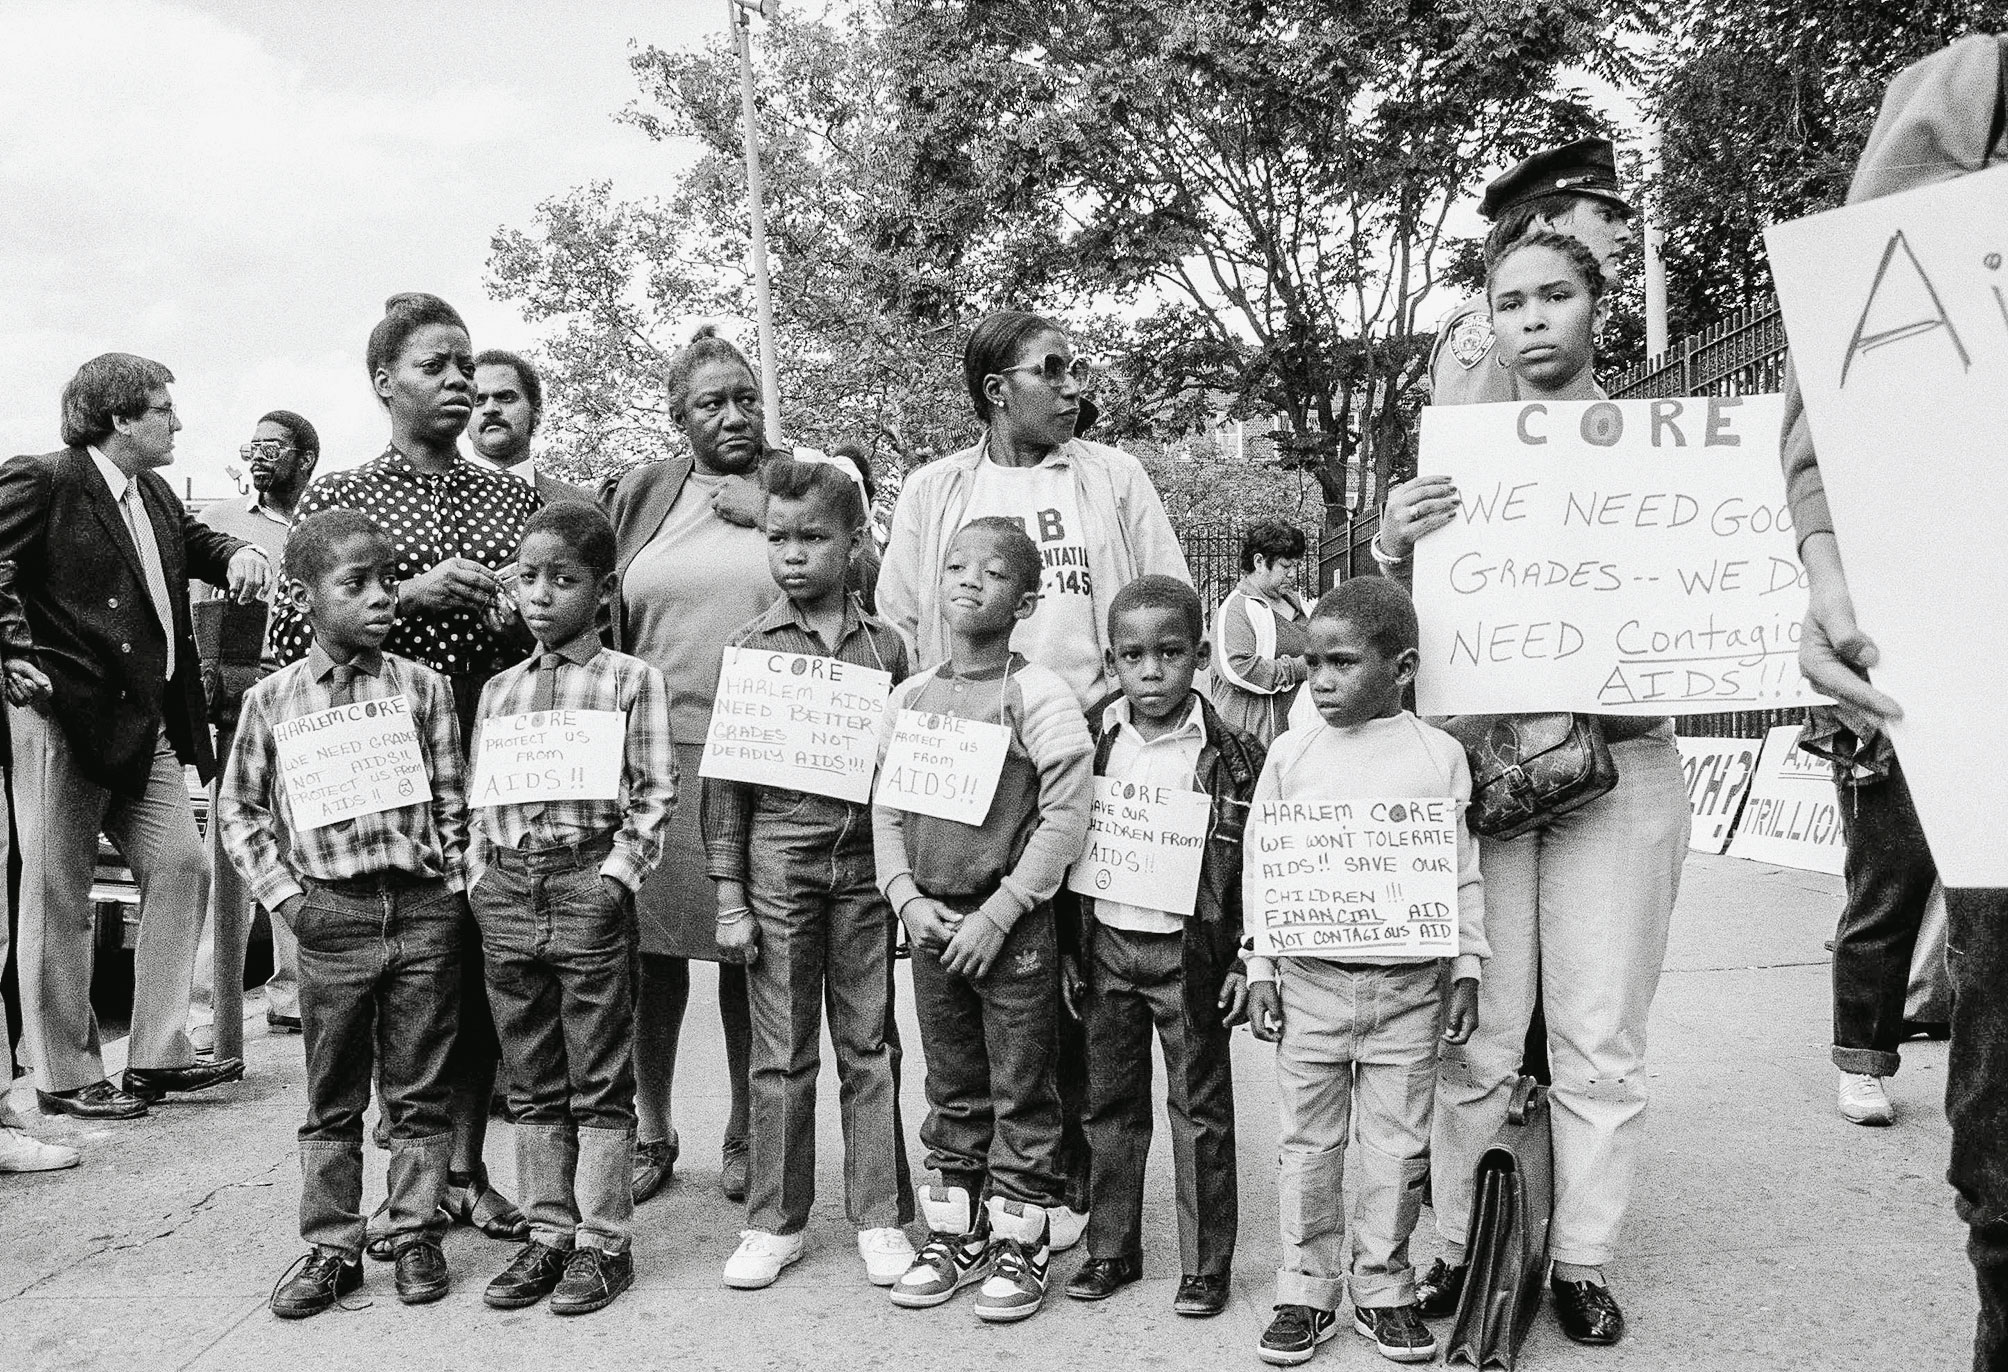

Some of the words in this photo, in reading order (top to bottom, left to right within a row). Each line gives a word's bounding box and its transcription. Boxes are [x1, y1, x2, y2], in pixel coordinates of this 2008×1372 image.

[1515, 397, 1744, 448] CORE
[1457, 480, 1539, 526] WE
[1563, 490, 1700, 529] NEED
[1037, 508, 1065, 543] B
[1677, 558, 1750, 597] WE
[1449, 620, 1585, 667] NEED
[767, 654, 844, 682] CORE
[726, 676, 813, 700] HARLEM
[830, 689, 883, 713] KIDS
[276, 709, 346, 743] HARLEM
[347, 696, 408, 722] CORE
[514, 710, 577, 731] CORE
[716, 698, 772, 718] NEED
[787, 704, 875, 736] BETTER
[917, 712, 968, 735] CORE
[485, 731, 550, 752] PROTECT
[565, 730, 591, 744] US
[713, 721, 788, 742] GRADES
[811, 731, 858, 751] NOT
[895, 731, 946, 749] PROTECT
[284, 755, 310, 772] WE
[316, 740, 363, 760] NEED
[516, 749, 564, 763] FROM
[711, 743, 785, 763] DEADLY
[912, 751, 954, 768] FROM
[288, 778, 361, 806] PROTECT
[370, 770, 392, 784] US
[292, 770, 328, 791] NOT
[1110, 780, 1172, 806] CORE
[1121, 806, 1150, 823] OUR
[1262, 801, 1353, 826] HARLEM
[1370, 801, 1444, 824] CORE
[1086, 817, 1154, 843] HILDREN
[1161, 830, 1204, 849] FROM
[1260, 835, 1296, 853] WE
[1363, 829, 1455, 848] TOLERATE
[1344, 855, 1398, 873] SAVE
[1411, 856, 1453, 873] OUR
[1264, 907, 1388, 927] FINANCIAL
[1408, 901, 1450, 919] AID
[1269, 930, 1305, 950] NOT
[1312, 925, 1411, 946] CONTAGIOUS
[1419, 923, 1451, 938] AID
